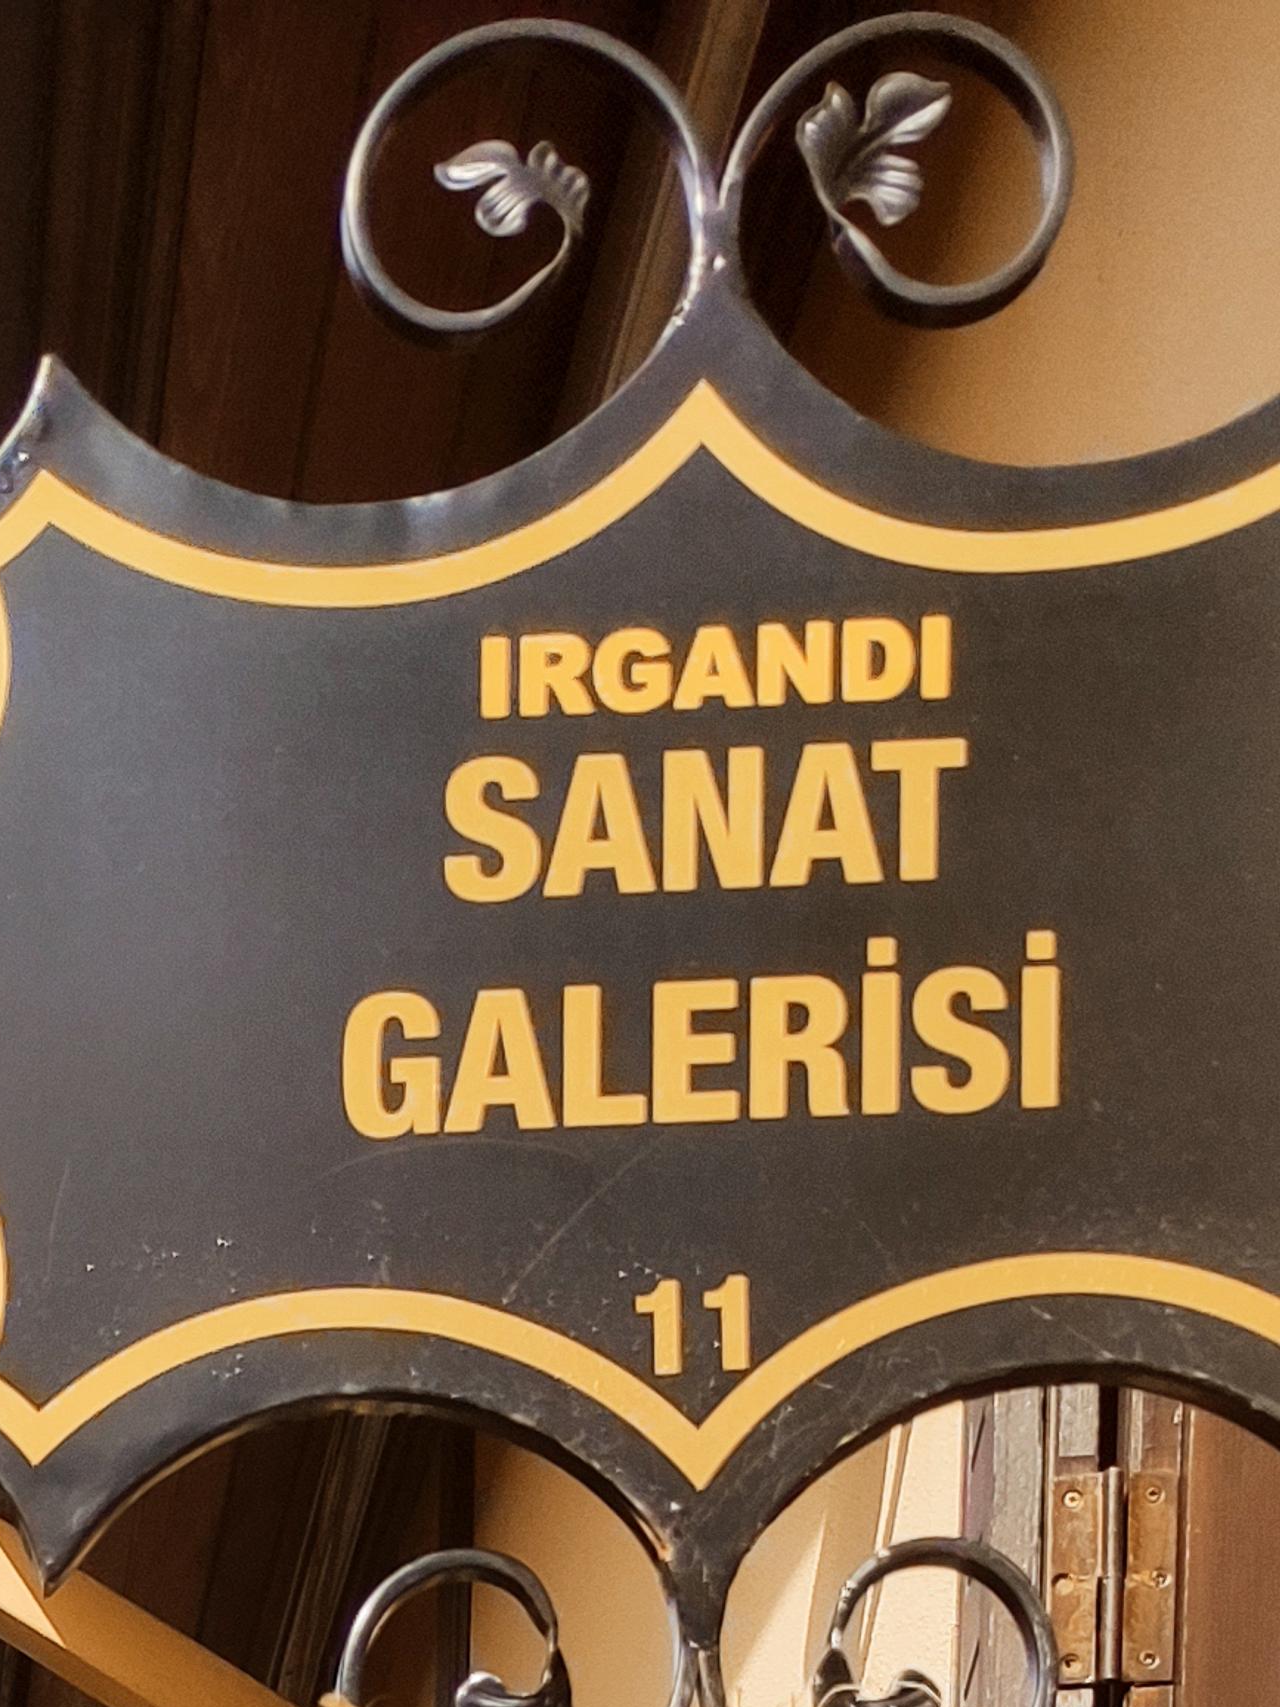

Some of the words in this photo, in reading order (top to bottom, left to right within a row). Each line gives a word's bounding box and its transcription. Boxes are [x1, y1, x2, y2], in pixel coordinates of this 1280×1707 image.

[481, 614, 951, 718] IRGANDI
[444, 738, 967, 902] SANAT
[343, 930, 1060, 1139] GALERİSİ
[636, 1275, 750, 1375] 11
